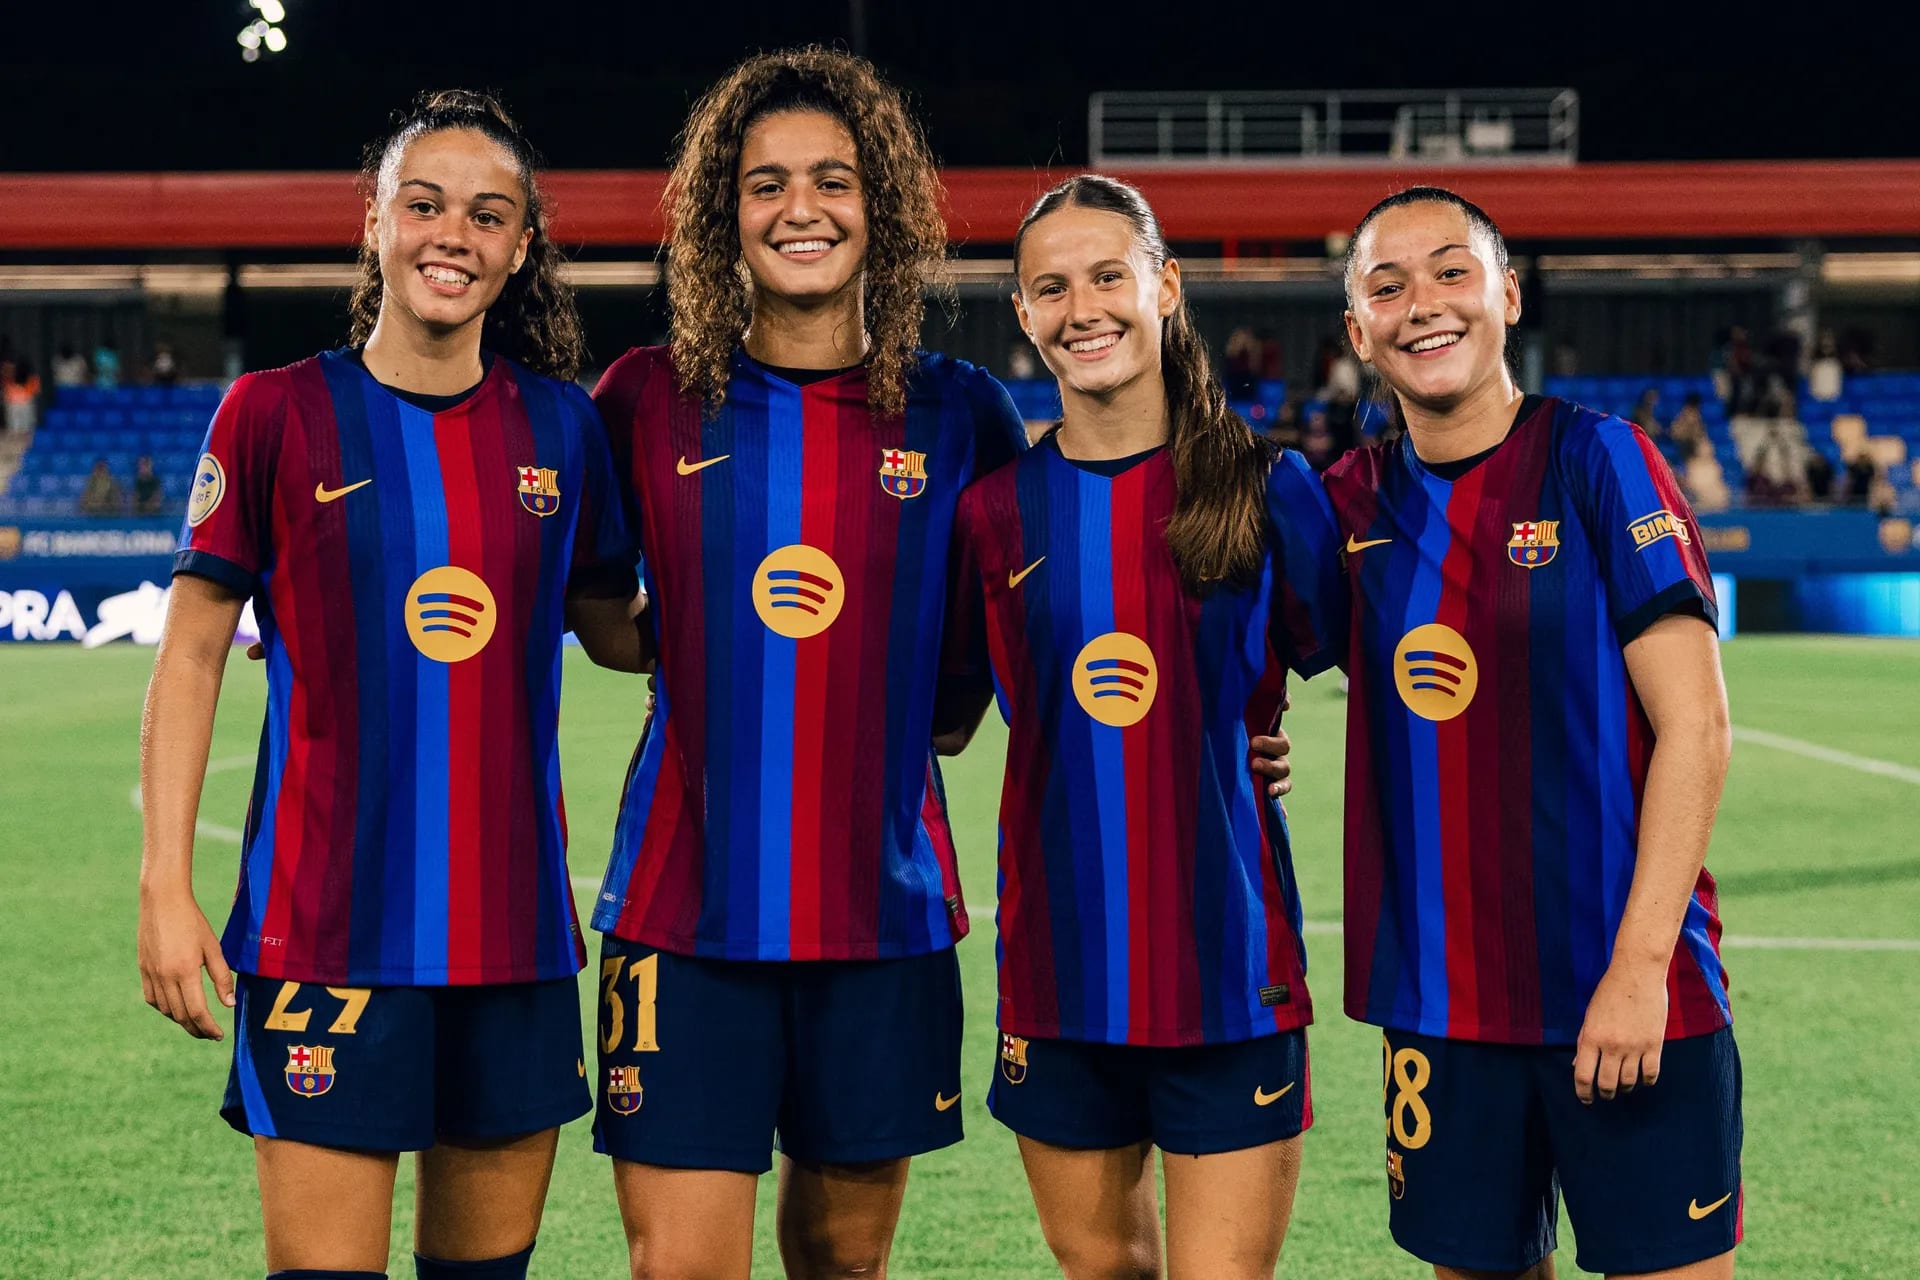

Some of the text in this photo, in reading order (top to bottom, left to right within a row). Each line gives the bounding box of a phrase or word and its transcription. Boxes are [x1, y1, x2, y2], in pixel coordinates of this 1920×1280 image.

[894, 469, 913, 477] FCB
[601, 952, 660, 1054] 31
[299, 1066, 320, 1074] FCB
